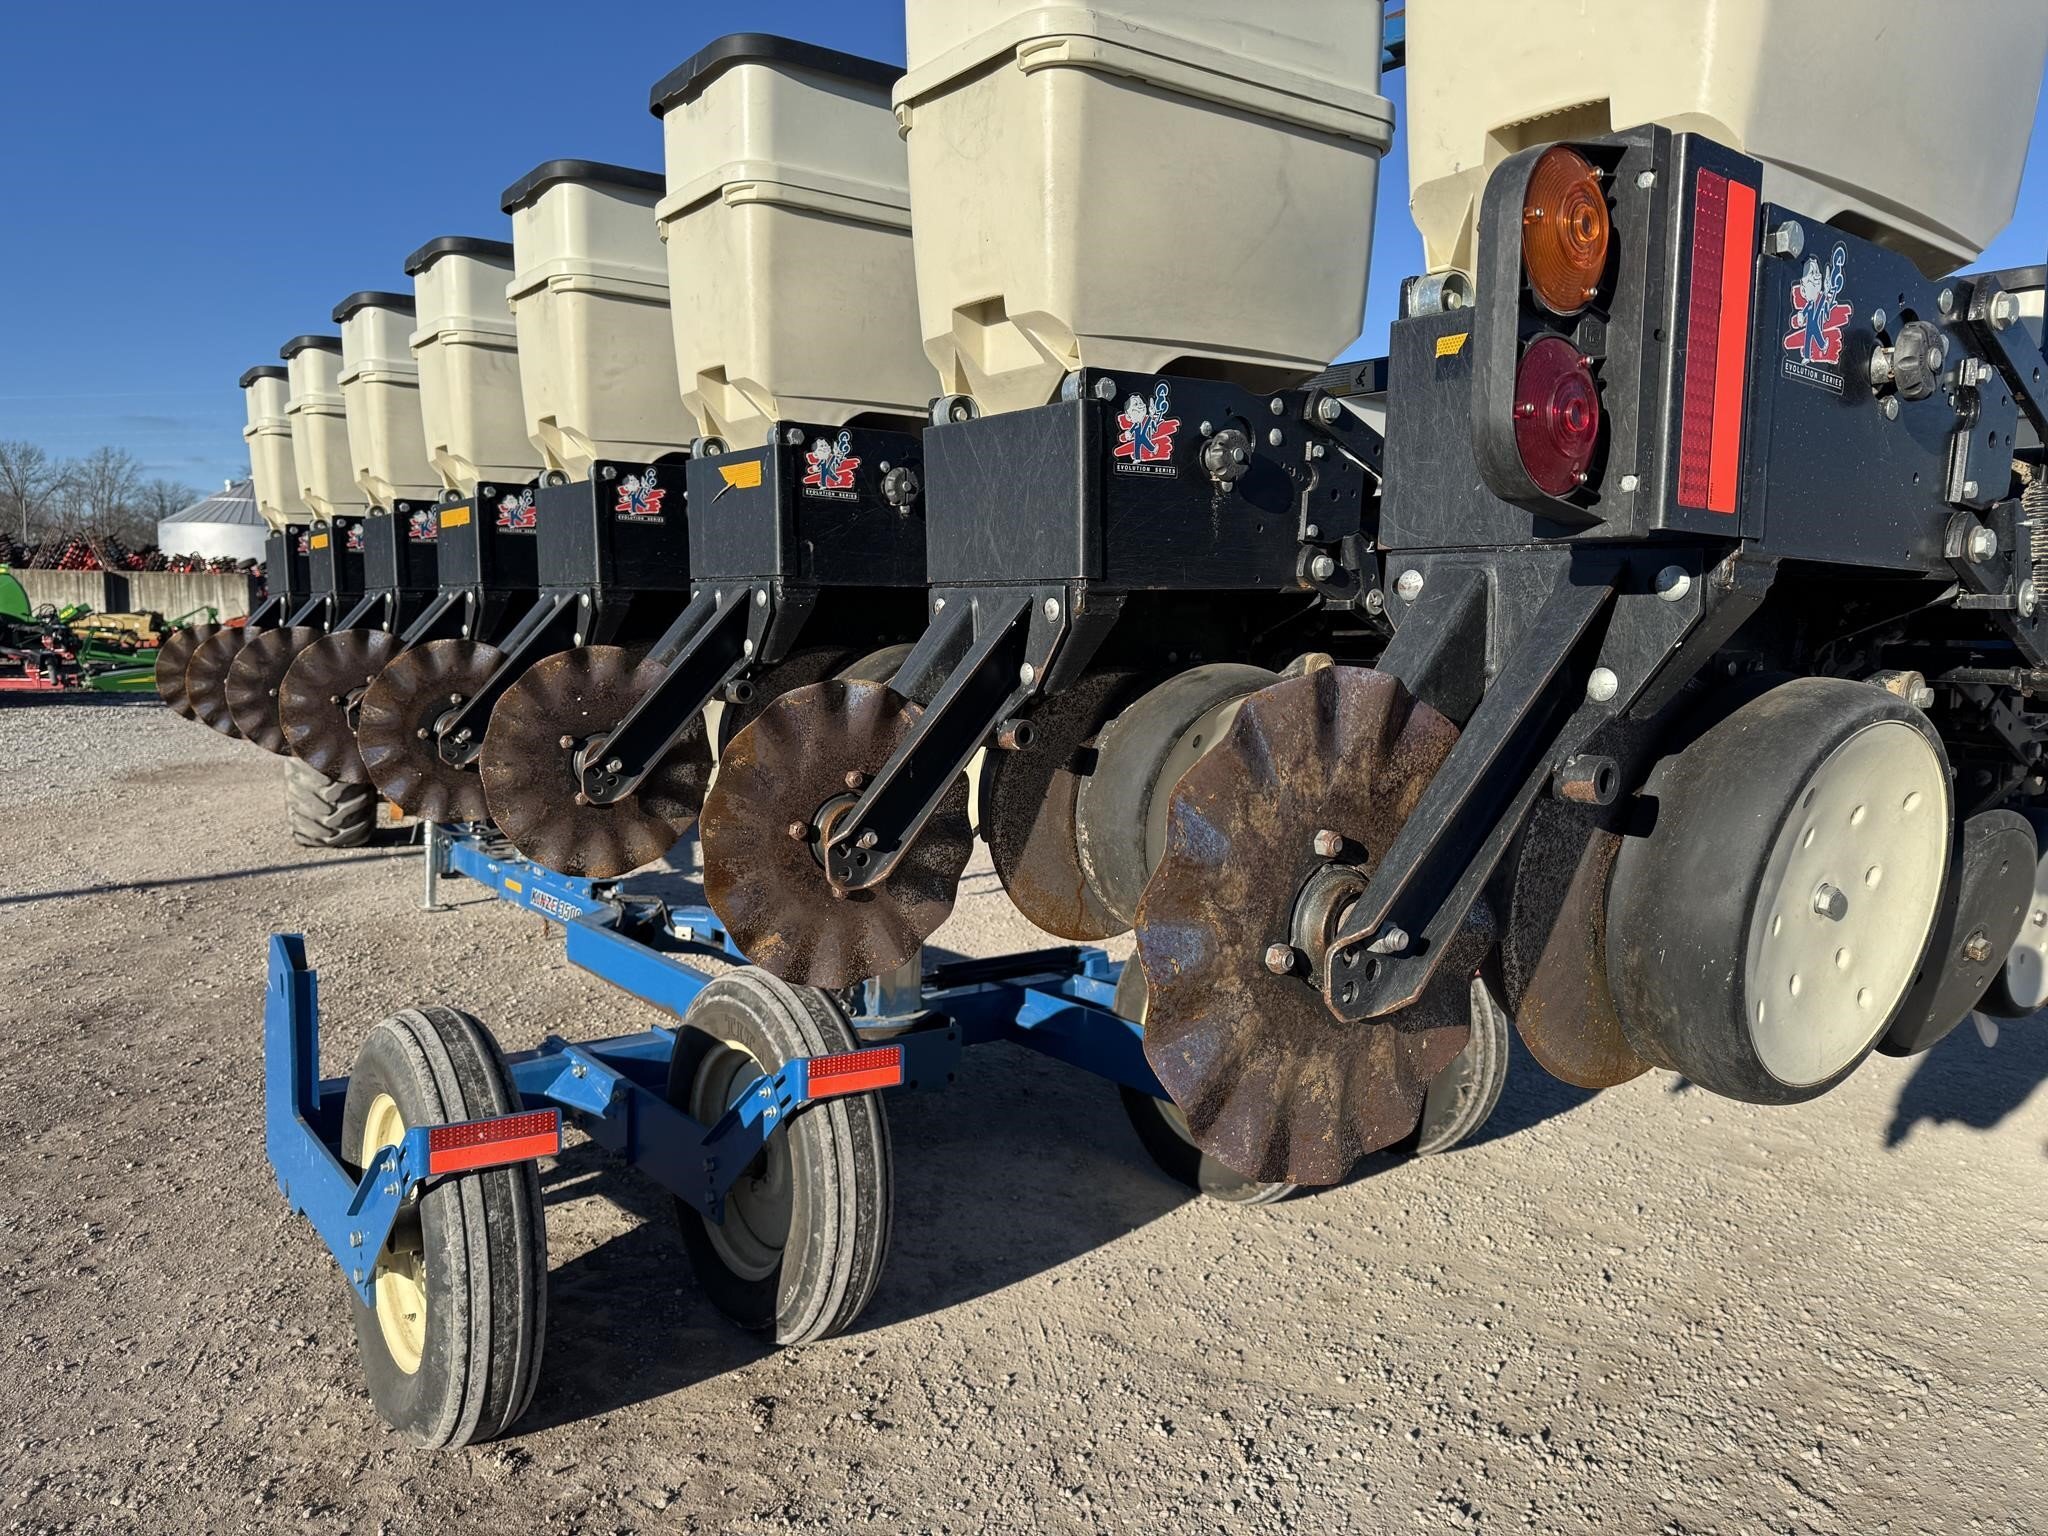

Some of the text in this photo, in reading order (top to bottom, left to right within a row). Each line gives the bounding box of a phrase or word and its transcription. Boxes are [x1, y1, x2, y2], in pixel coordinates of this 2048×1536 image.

[1784, 362, 1843, 387] EVOLUTION SERIES
[1116, 464, 1151, 472] EVOLUTION
[531, 888, 559, 915] KINZE
